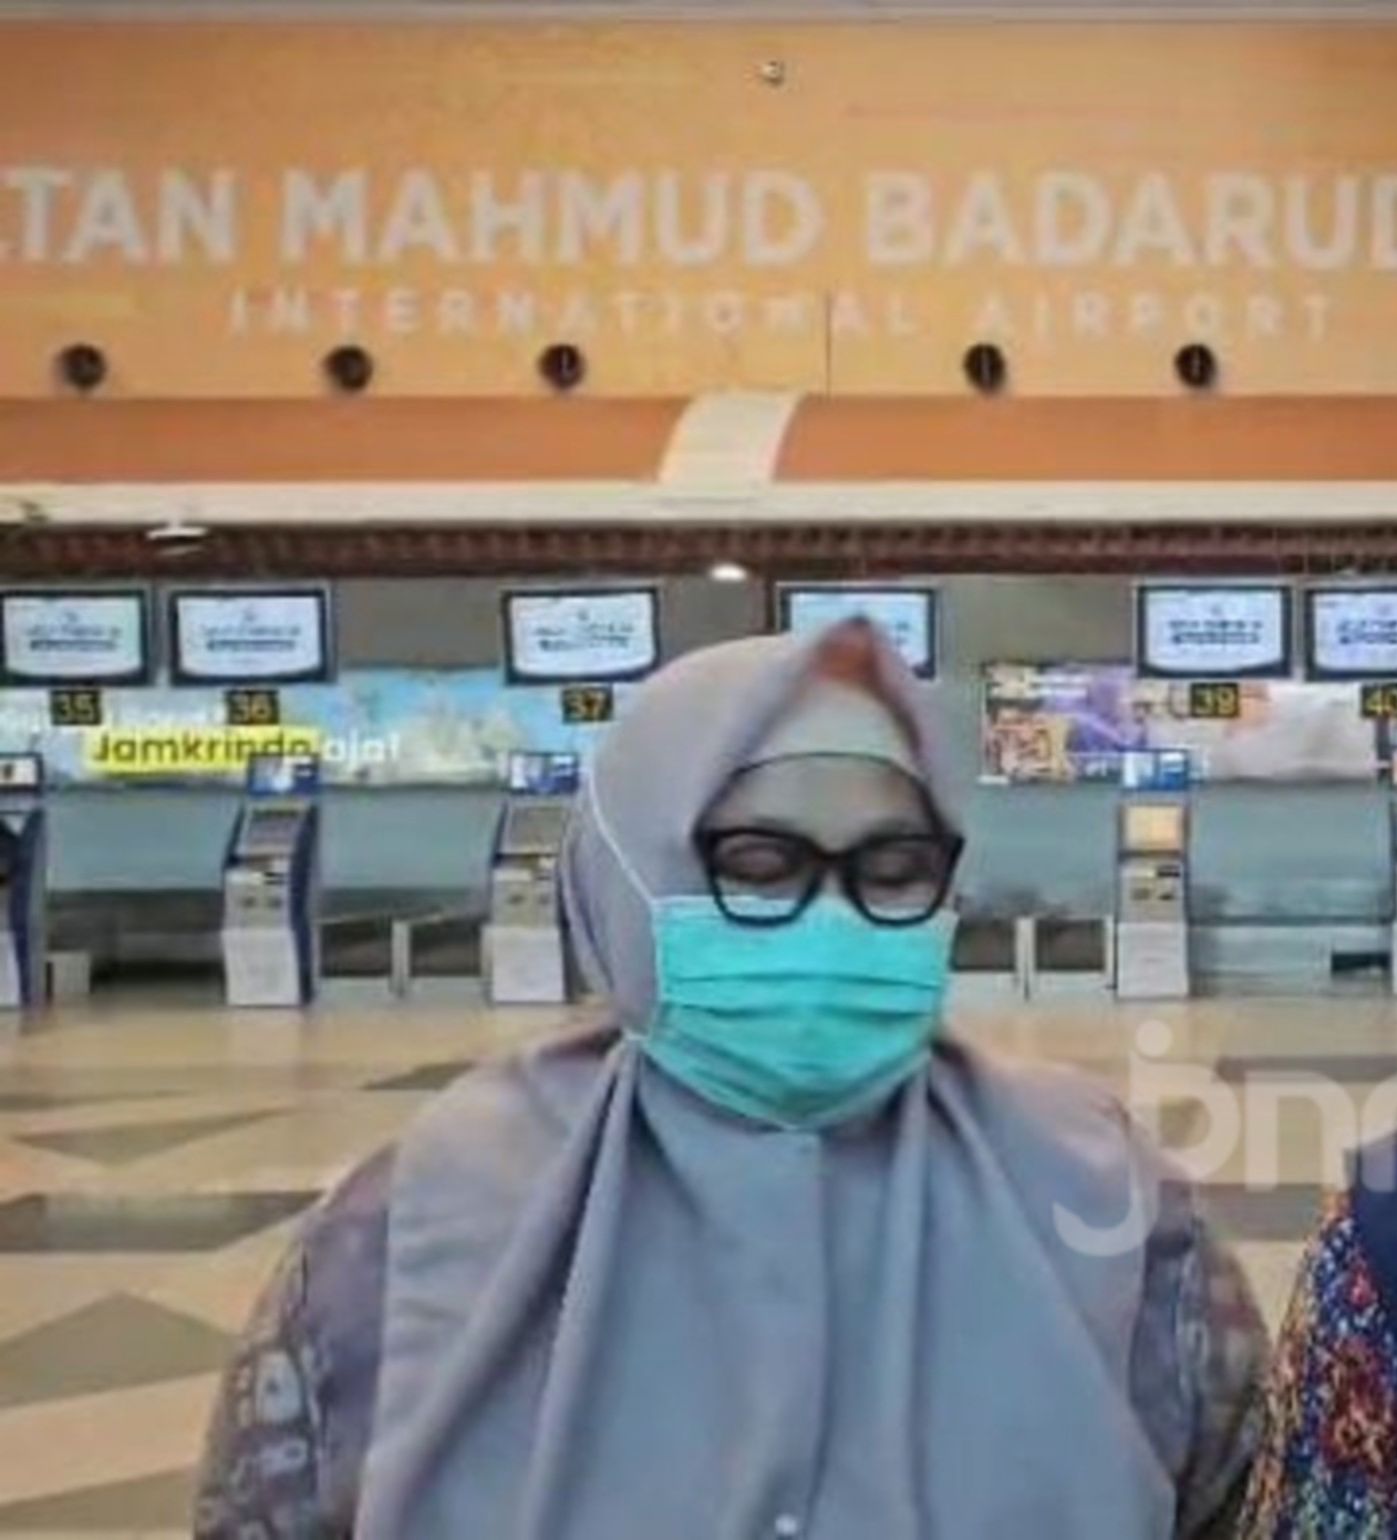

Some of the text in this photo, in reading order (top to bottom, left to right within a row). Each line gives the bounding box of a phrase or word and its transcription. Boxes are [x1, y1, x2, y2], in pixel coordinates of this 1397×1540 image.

[281, 166, 825, 265] MAHMUD
[228, 287, 1333, 342] INTERNATIONAL AIRPORT
[55, 693, 97, 721] 35
[231, 694, 274, 720] 36
[1195, 686, 1236, 716] 39
[92, 731, 312, 764] Jamkrindo
